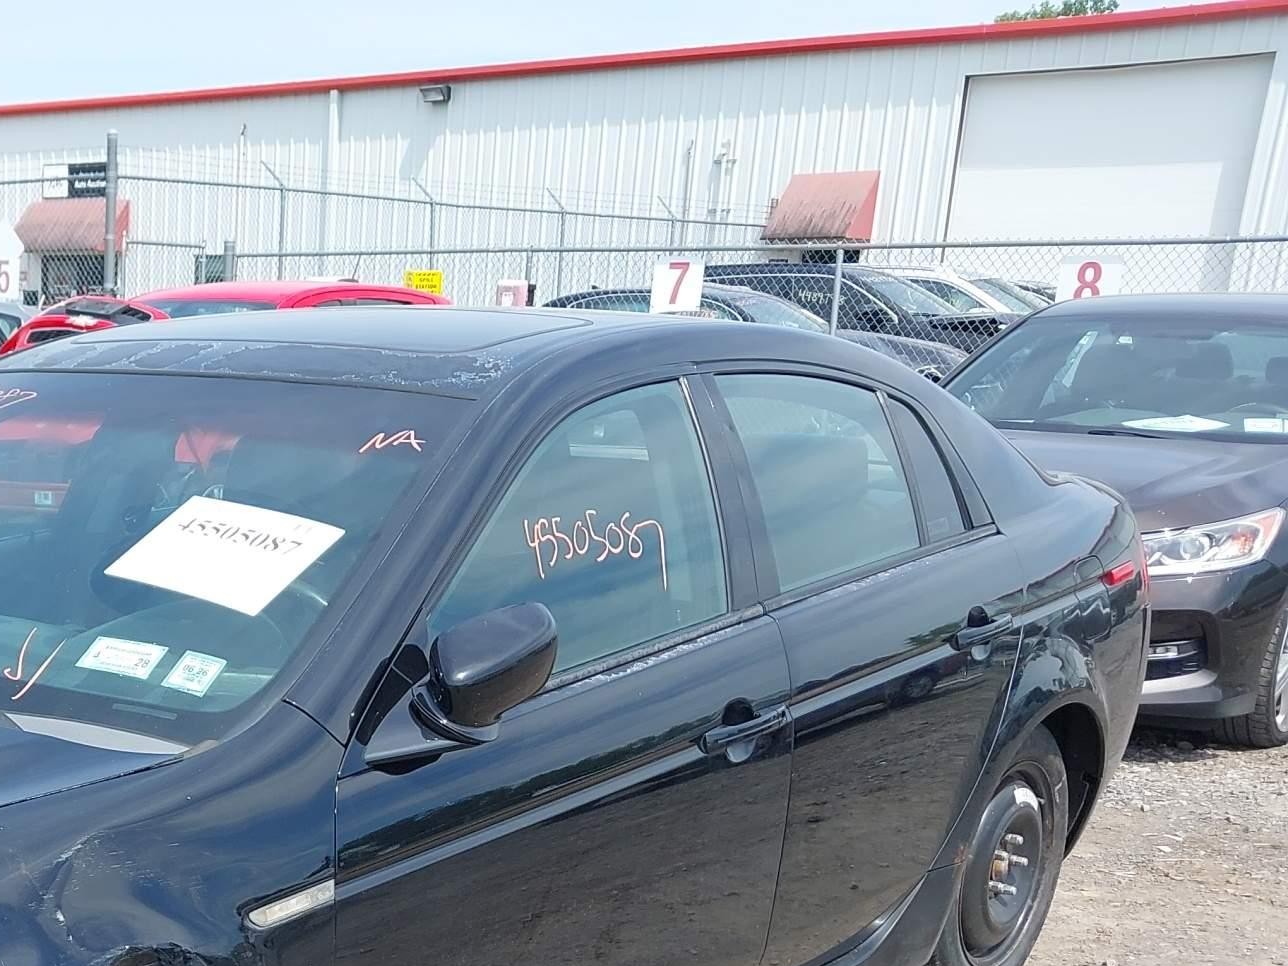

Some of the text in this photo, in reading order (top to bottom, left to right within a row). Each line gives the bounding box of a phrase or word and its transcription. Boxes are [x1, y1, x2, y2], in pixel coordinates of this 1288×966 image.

[669, 262, 690, 304] 7
[1073, 261, 1102, 299] 8
[358, 429, 426, 453] NA
[178, 517, 303, 555] 45505087
[523, 509, 668, 592] 45505087
